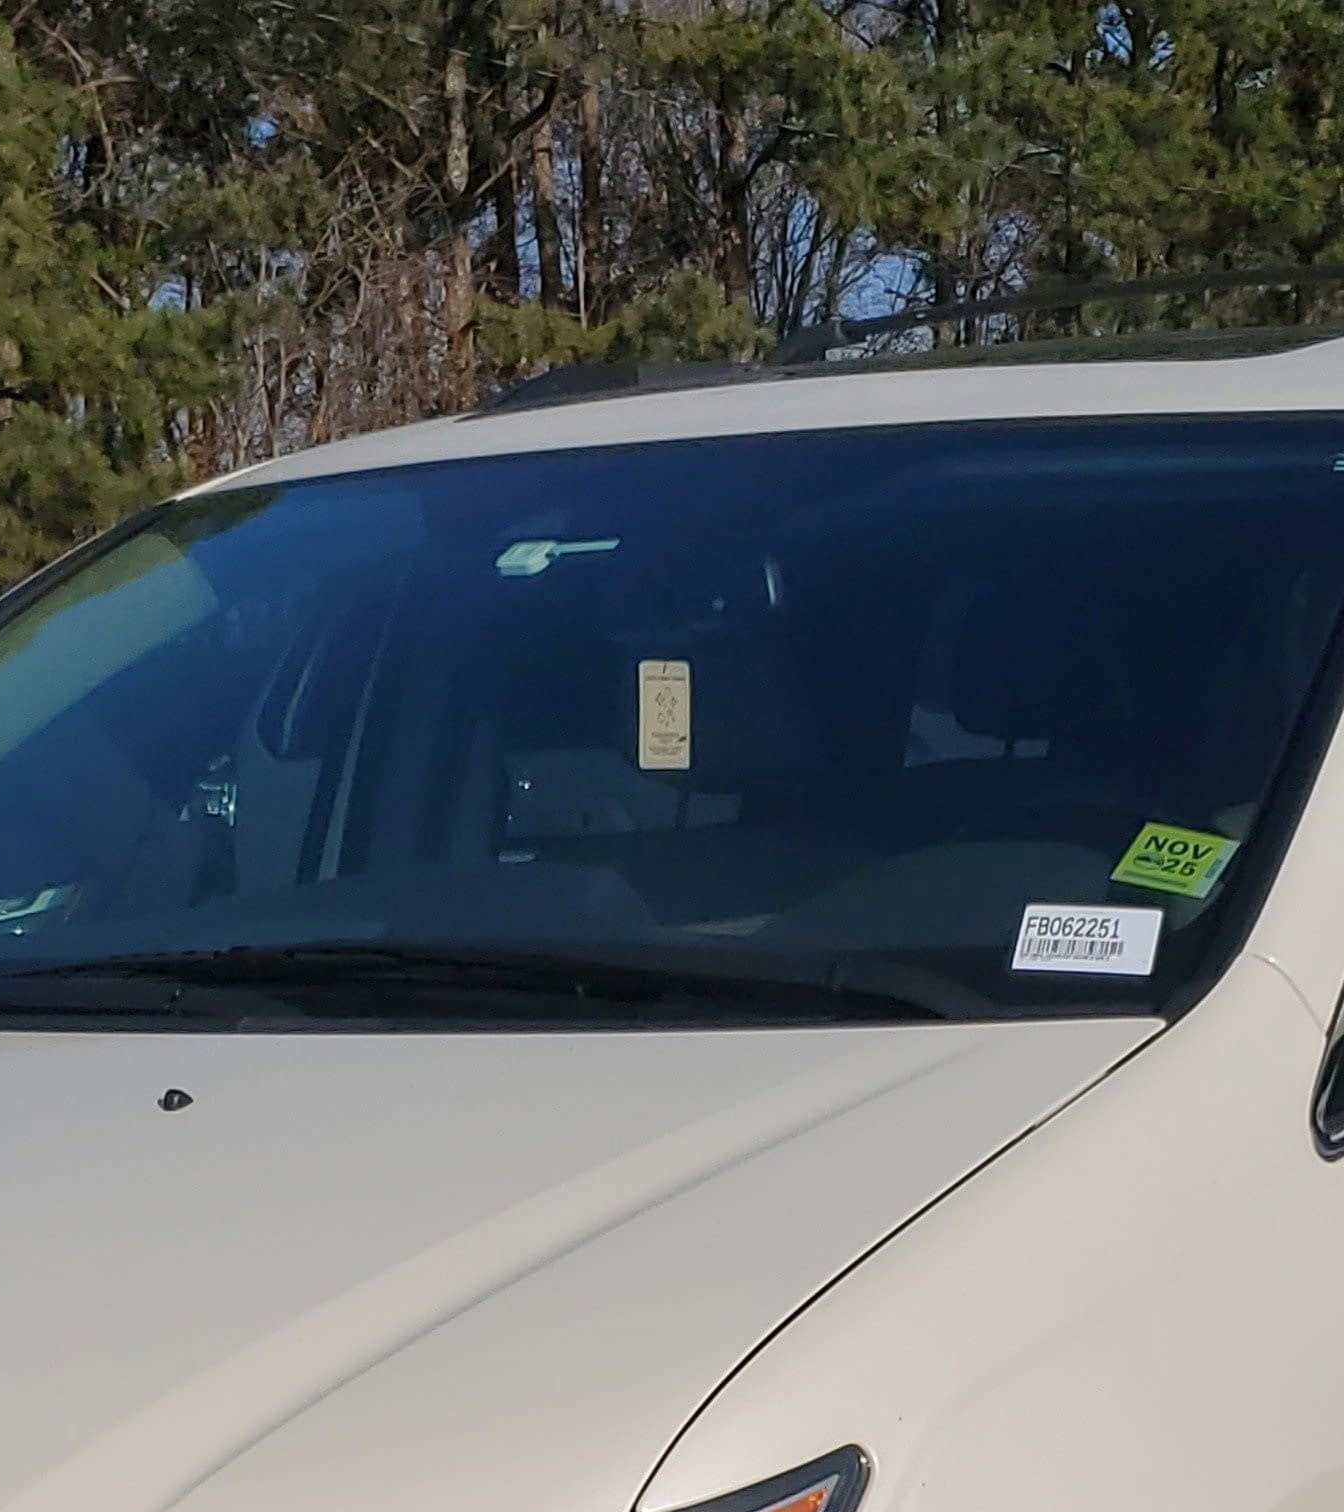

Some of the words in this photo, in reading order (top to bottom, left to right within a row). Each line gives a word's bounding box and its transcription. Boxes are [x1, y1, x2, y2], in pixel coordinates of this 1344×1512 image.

[1144, 835, 1213, 860] NOV
[1161, 858, 1197, 877] 25
[1025, 915, 1120, 939] FB062251
